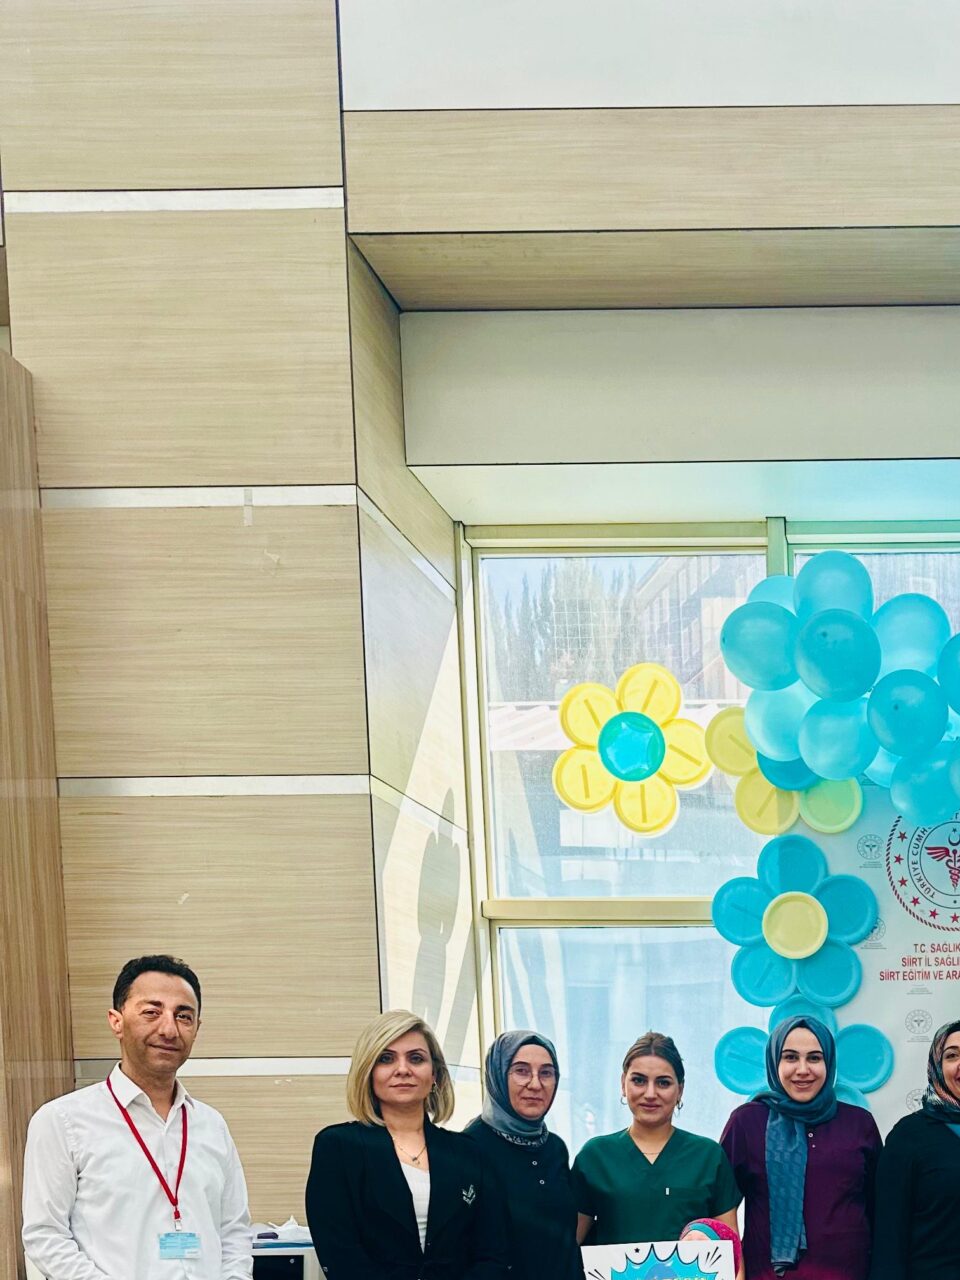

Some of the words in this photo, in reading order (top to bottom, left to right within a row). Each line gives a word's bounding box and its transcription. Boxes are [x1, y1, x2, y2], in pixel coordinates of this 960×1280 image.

[912, 861, 935, 898] TÜRKİYE
[931, 942, 960, 953] SAĞLIK
[925, 955, 931, 966] İL
[903, 969, 930, 980] EĞİTİM
[934, 971, 943, 980] VE
